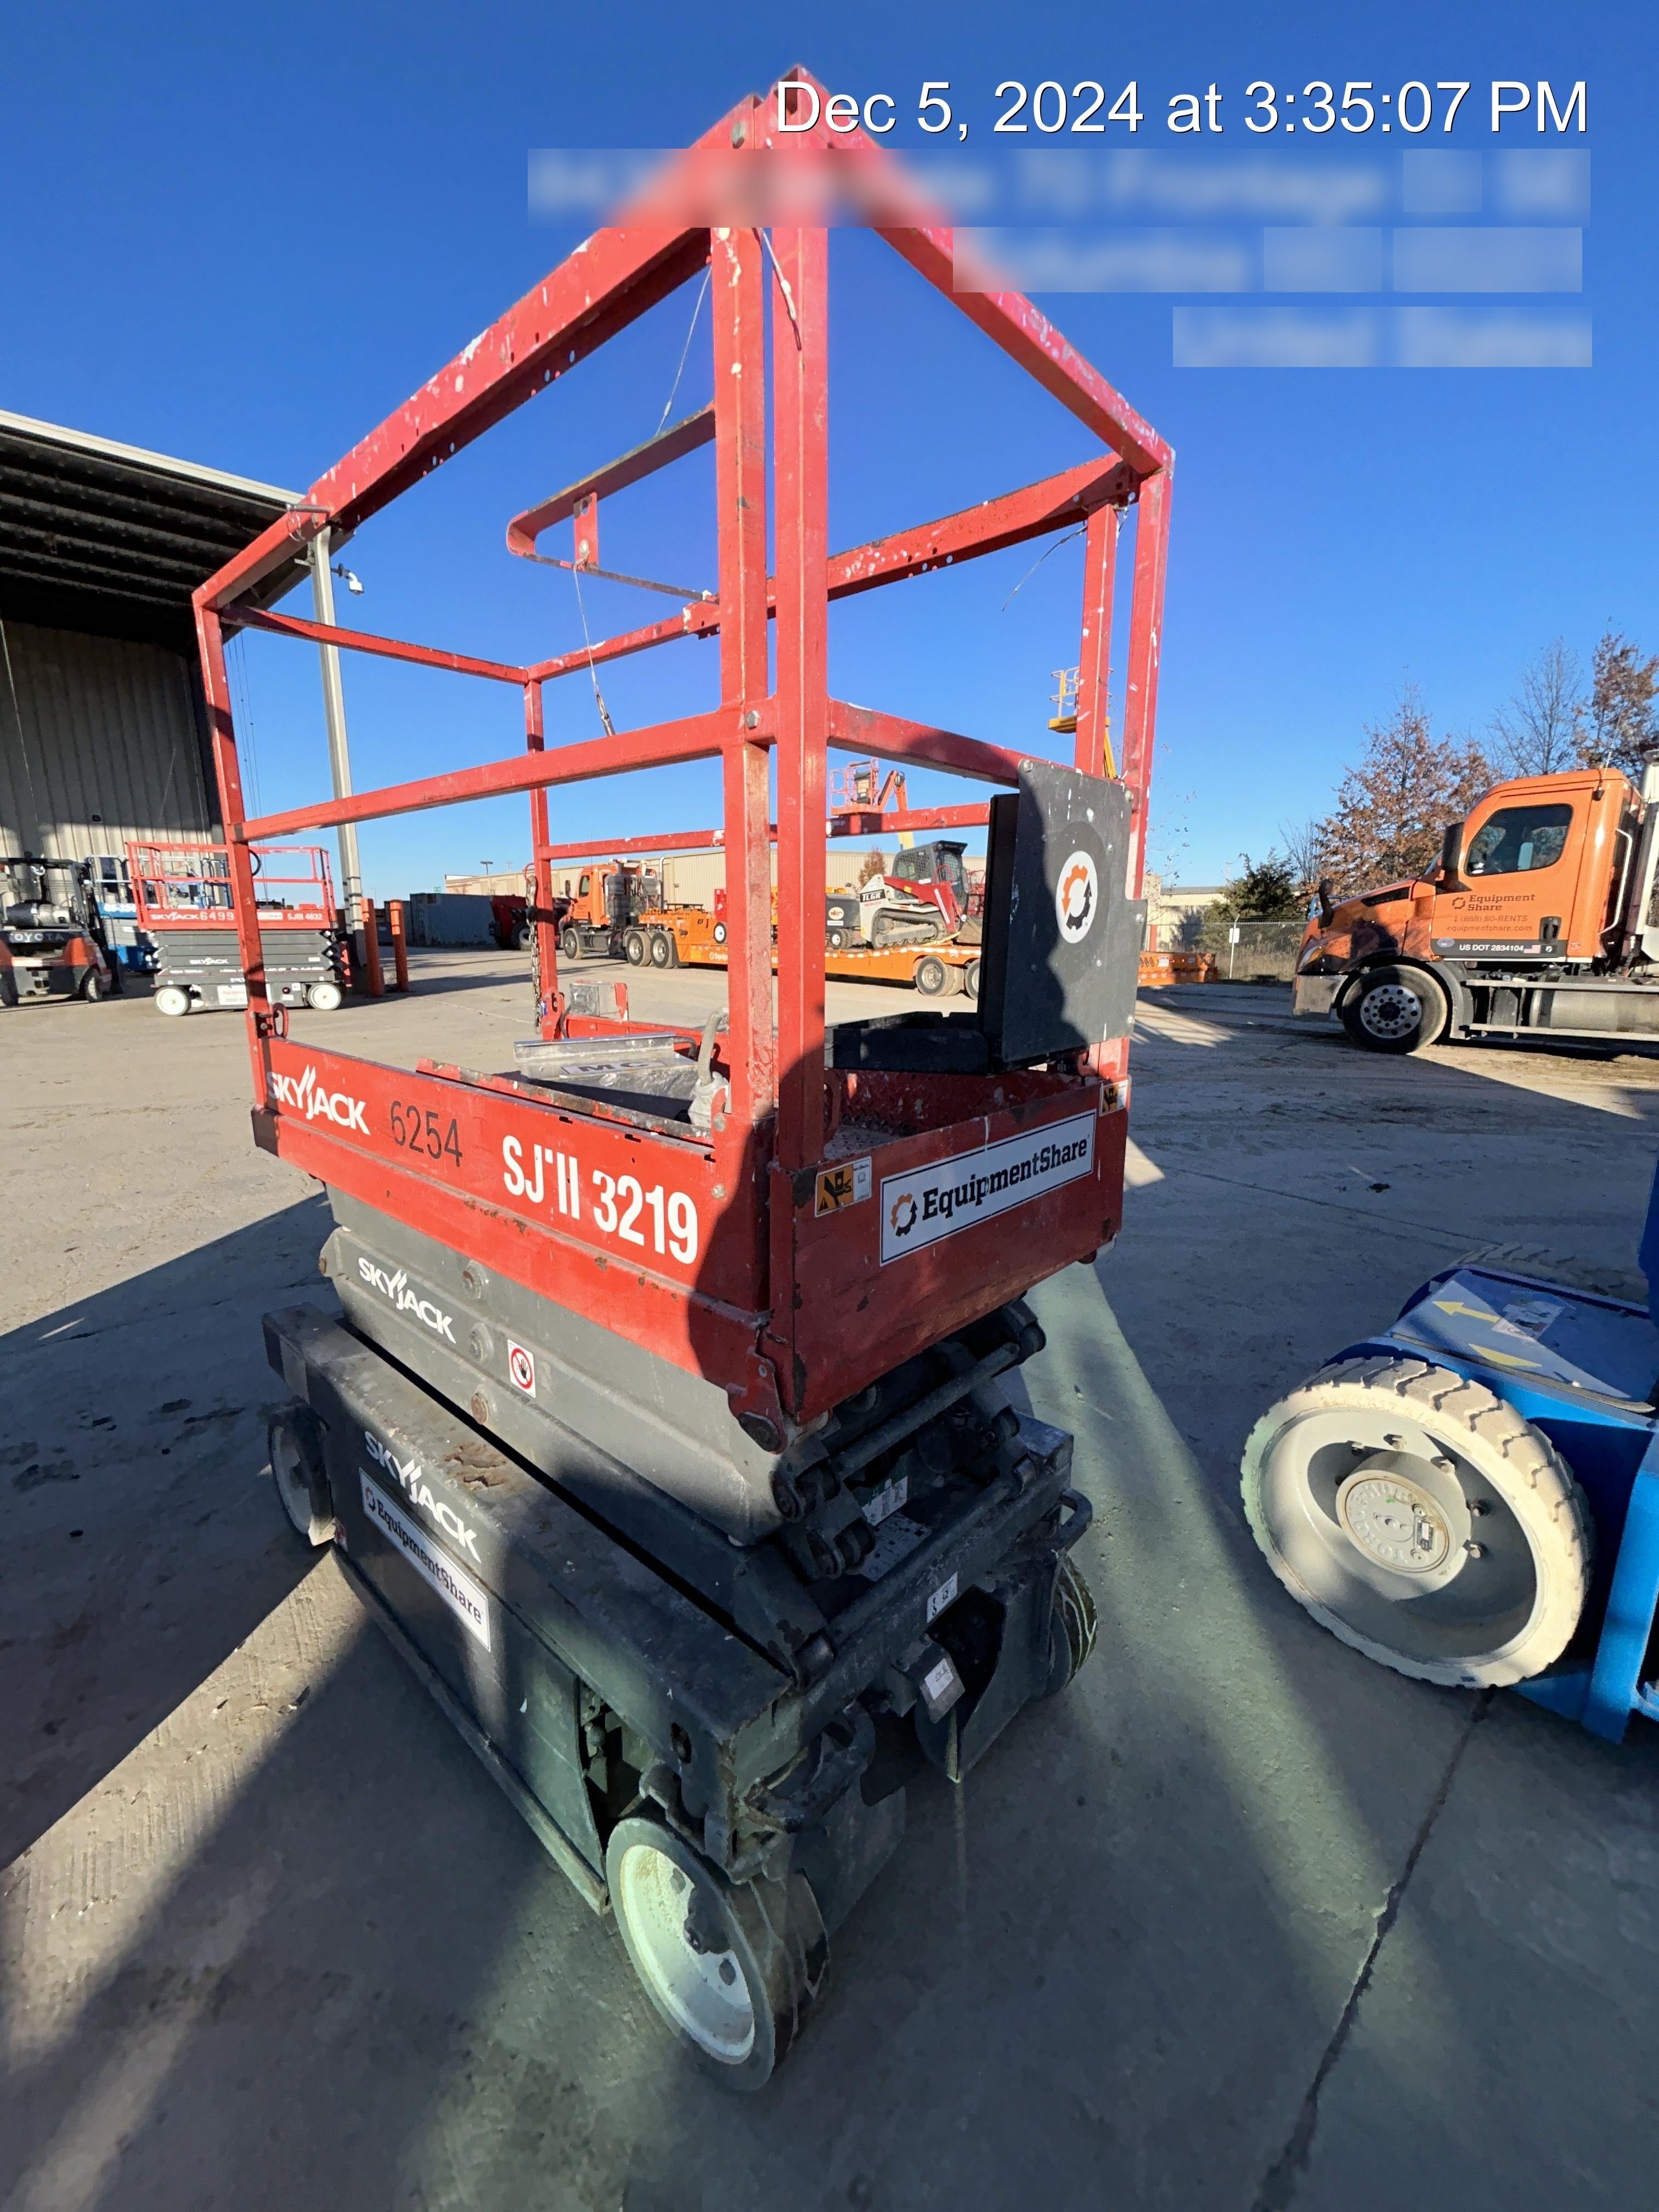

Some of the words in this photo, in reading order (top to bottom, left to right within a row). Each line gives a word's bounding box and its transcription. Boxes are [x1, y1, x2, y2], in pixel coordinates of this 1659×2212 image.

[151, 912, 199, 921] SKYJACK
[200, 912, 234, 921] 6499
[1469, 894, 1536, 904] Equipment
[267, 1064, 371, 1136] SKYJACK
[391, 1101, 463, 1167] 6254
[592, 1169, 698, 1265] 3219
[923, 1137, 1087, 1221] EquipmentShare
[358, 1257, 456, 1344] SKYJACK
[365, 1431, 482, 1564] SKYJACK
[377, 1500, 482, 1625] EquipmentShare
